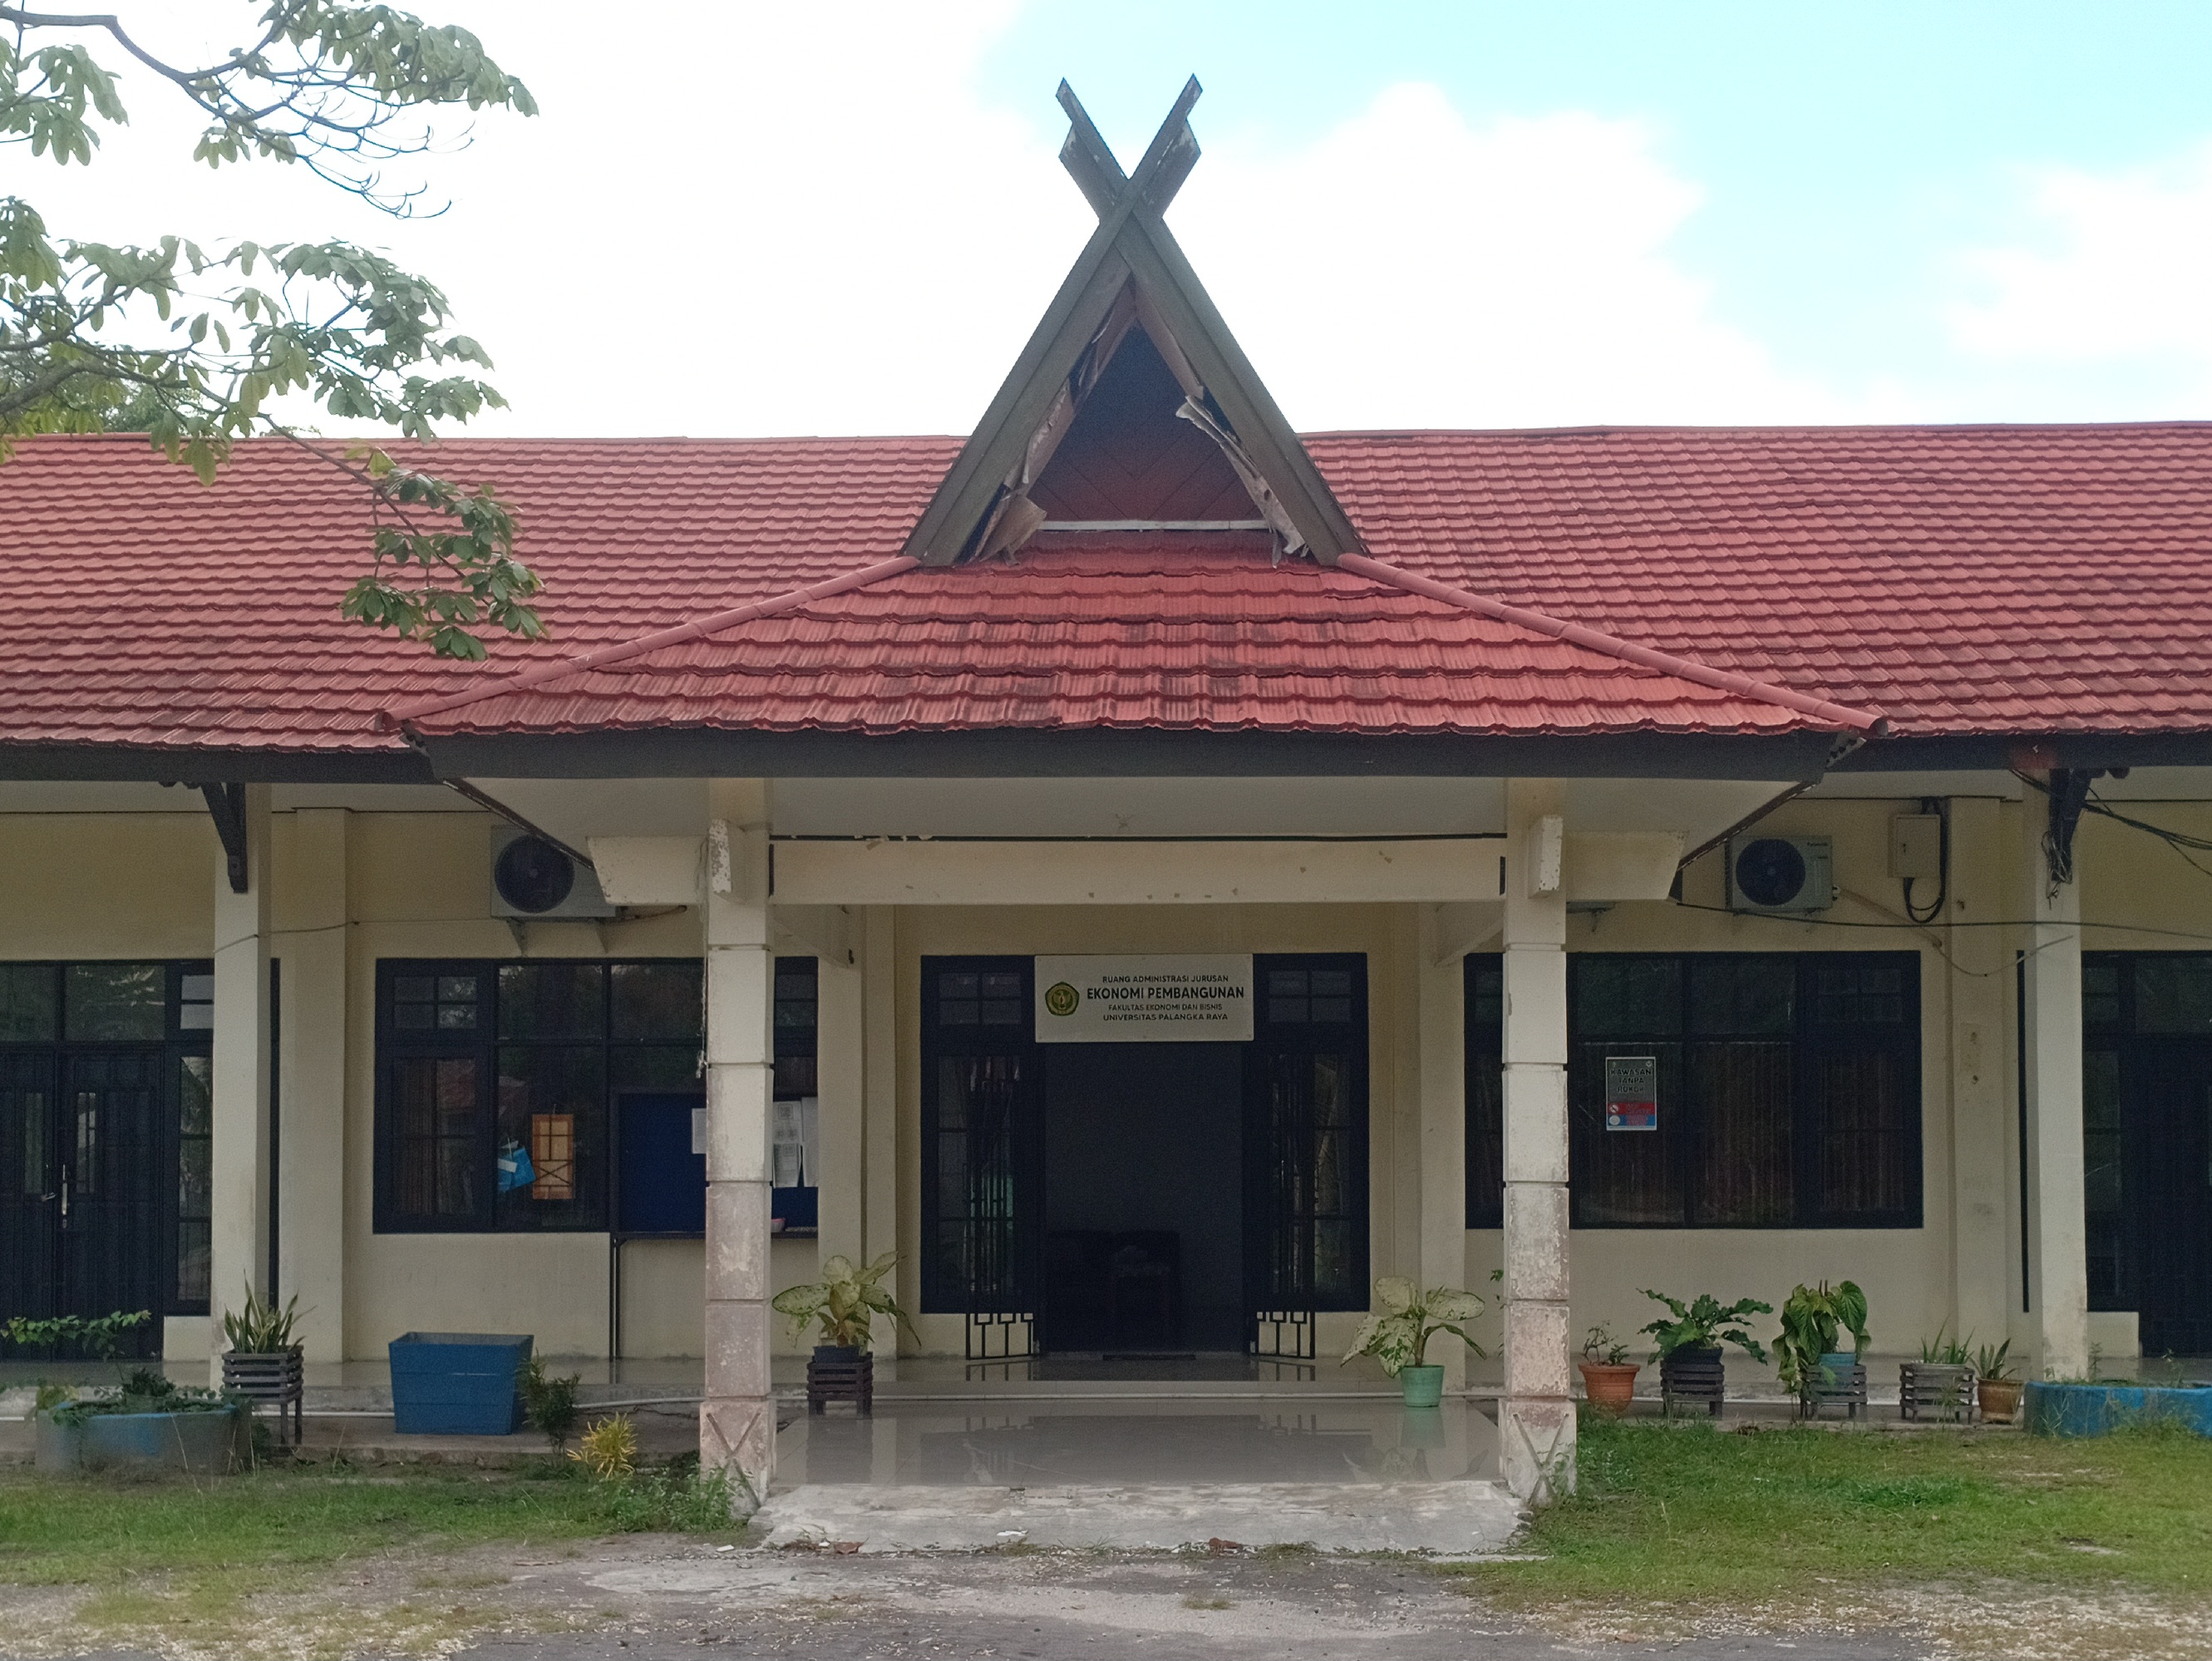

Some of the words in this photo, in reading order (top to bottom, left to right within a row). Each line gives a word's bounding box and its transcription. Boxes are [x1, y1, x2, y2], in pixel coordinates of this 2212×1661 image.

[1102, 975, 1131, 983] RUANG
[1132, 975, 1190, 983] ADMINISTRASI
[1190, 974, 1229, 983] JURUSAN
[1086, 987, 1144, 1000] EKONOMI
[1147, 986, 1244, 999] PEMBANGUNAN
[1108, 1003, 1145, 1012] FAKULTAS
[1181, 1003, 1198, 1011] DAN
[1199, 1003, 1223, 1011] BISNIS
[1103, 1013, 1157, 1022] UNIVERSITAS
[1158, 1013, 1205, 1021] PALANGKA
[1206, 1013, 1228, 1021] RAYA
[1610, 1067, 1652, 1076] KAWASAN
